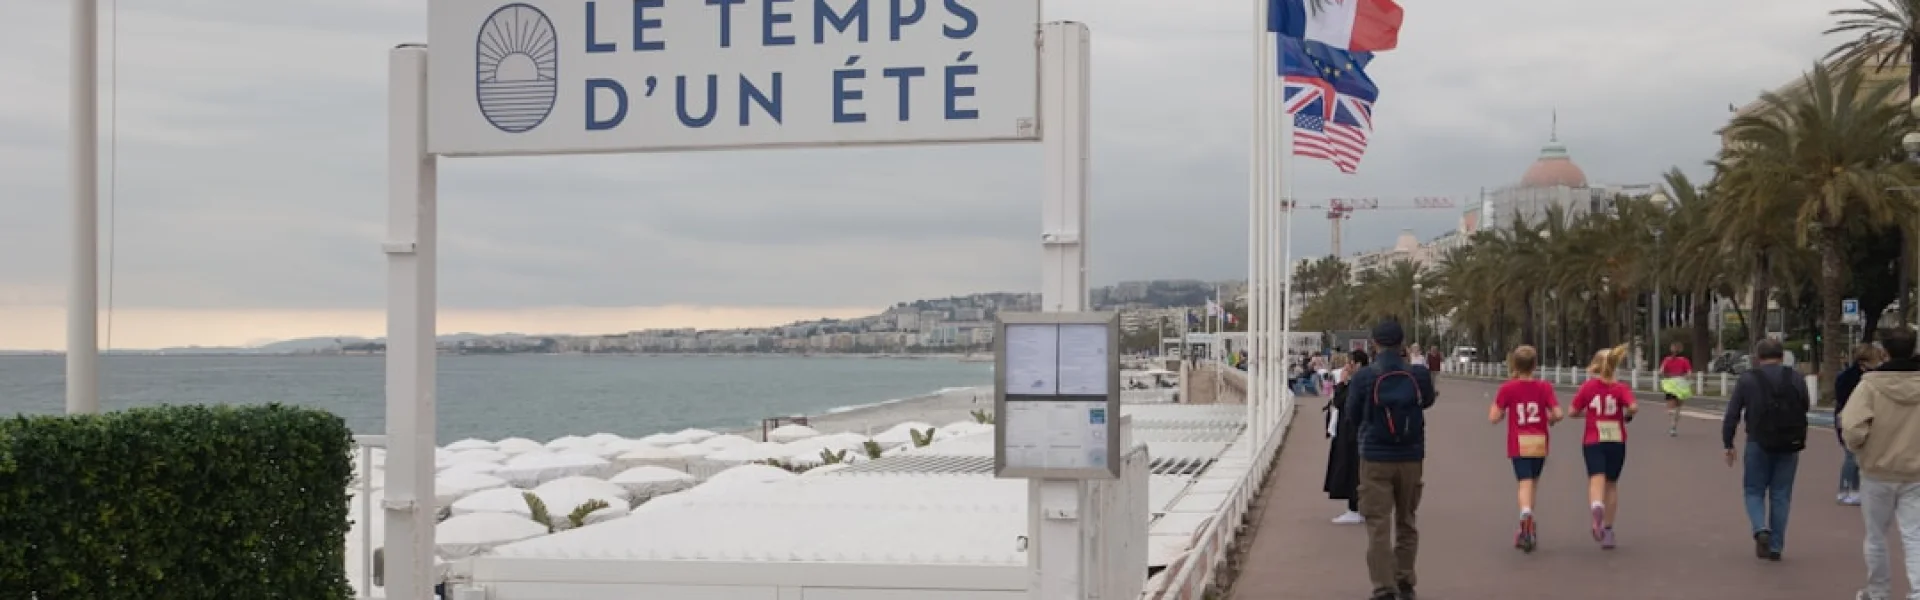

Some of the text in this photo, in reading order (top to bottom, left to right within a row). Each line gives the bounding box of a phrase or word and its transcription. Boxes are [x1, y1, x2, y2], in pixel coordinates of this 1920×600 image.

[585, 0, 978, 53] LE TEMPS
[832, 52, 979, 124] ÉTÉ
[1516, 402, 1541, 425] 12
